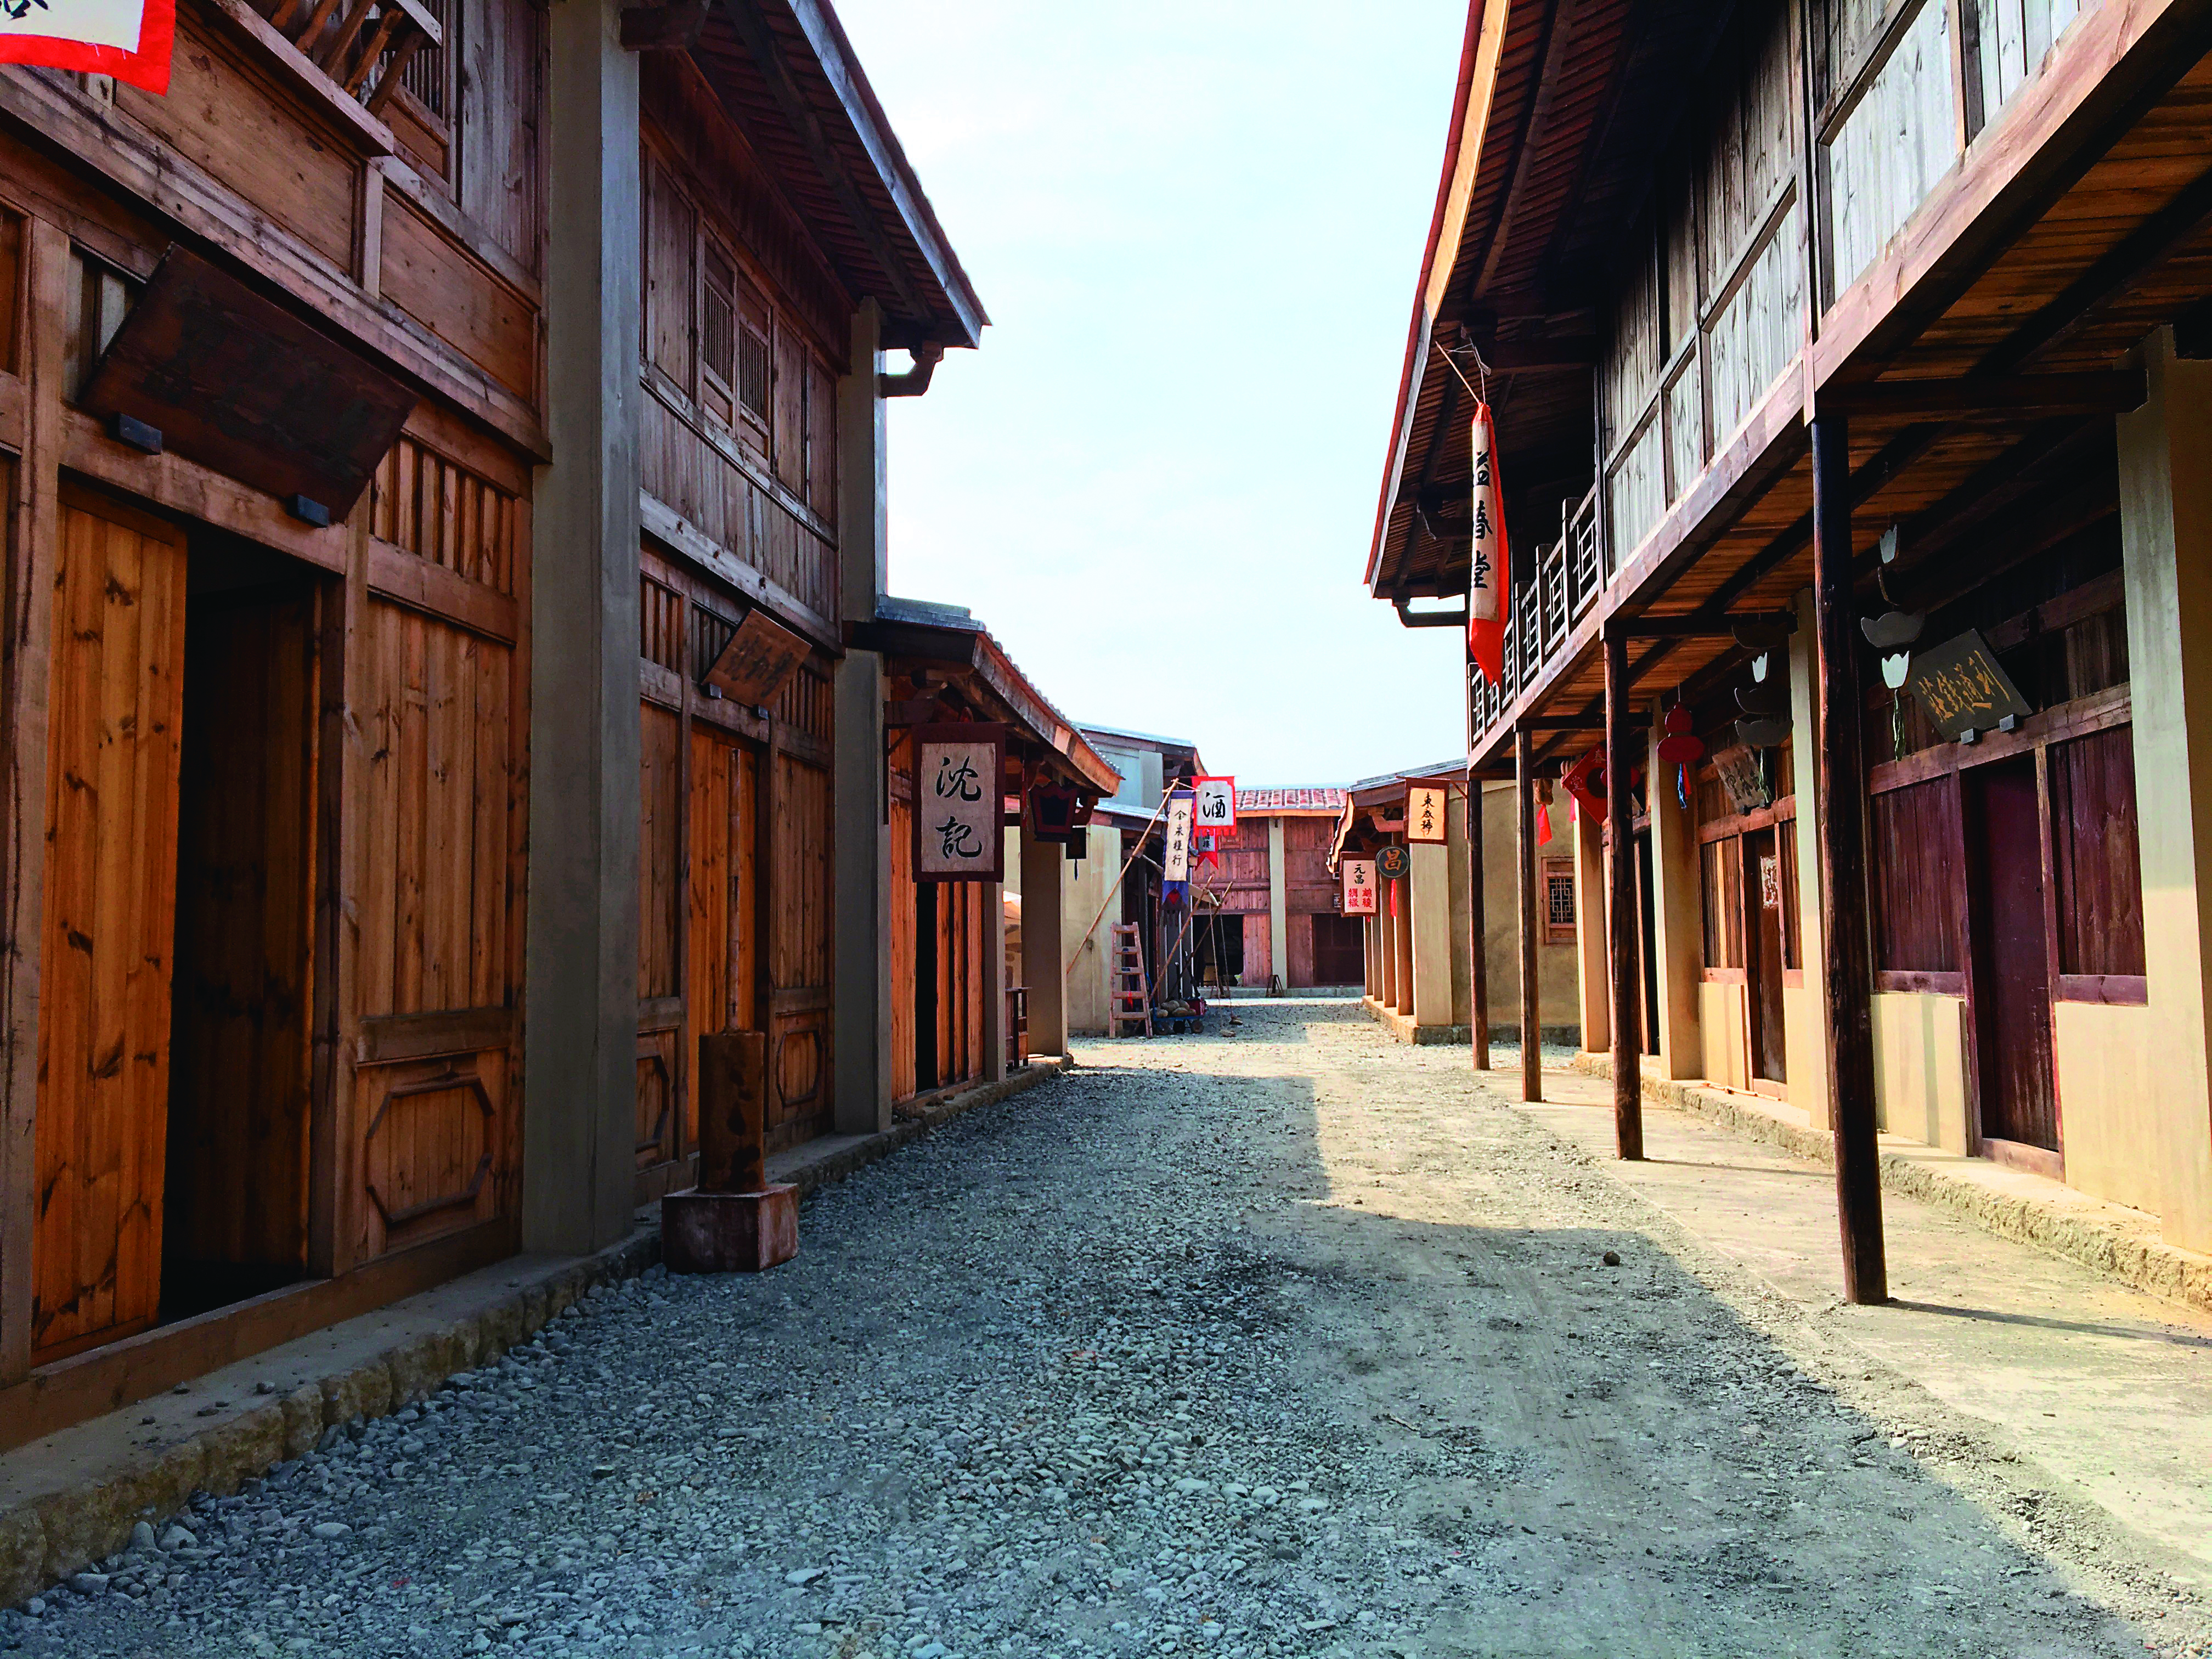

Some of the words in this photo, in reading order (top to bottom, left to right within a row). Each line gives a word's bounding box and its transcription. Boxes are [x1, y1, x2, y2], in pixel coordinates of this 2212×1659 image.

[935, 755, 983, 859] 沈記
[1203, 792, 1226, 819] 酒
[1384, 849, 1402, 871] 昌
[1353, 864, 1365, 884] 元昌
